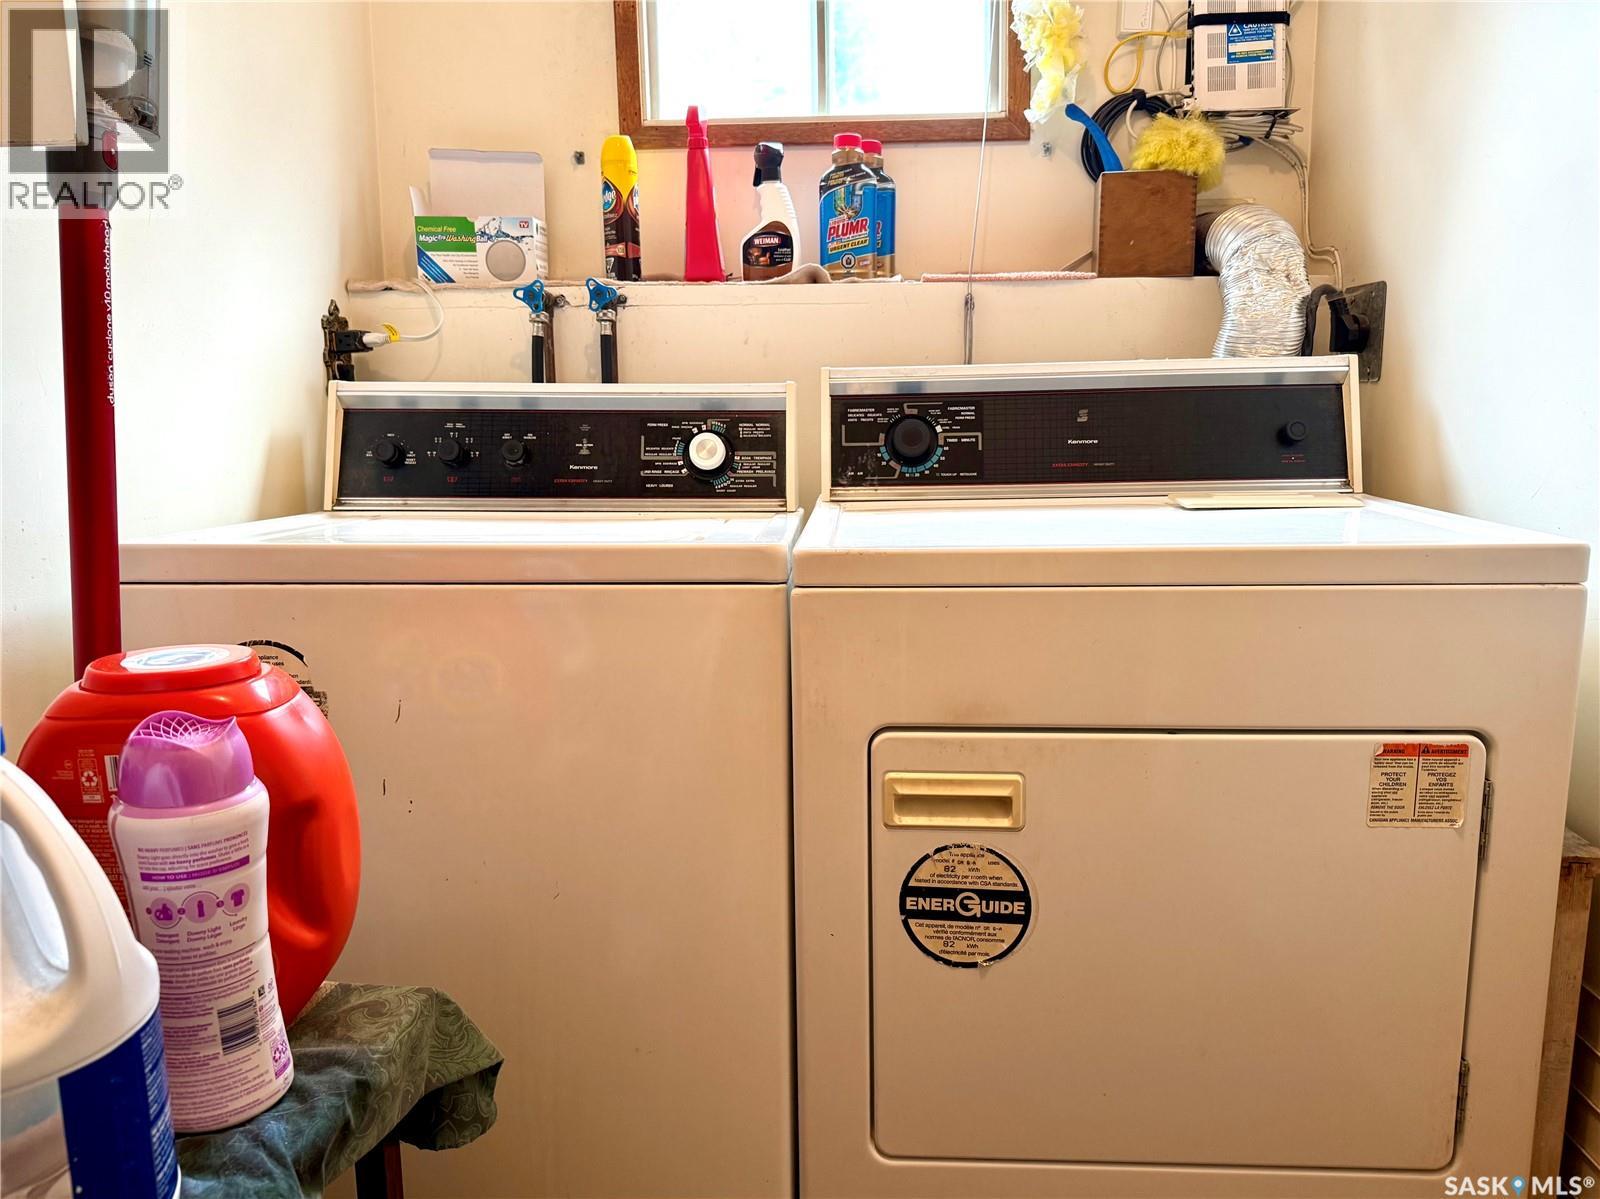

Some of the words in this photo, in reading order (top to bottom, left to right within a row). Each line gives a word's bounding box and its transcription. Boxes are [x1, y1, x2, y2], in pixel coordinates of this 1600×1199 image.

[418, 235, 438, 244] Magic
[446, 234, 476, 244] Washing
[754, 236, 779, 245] WEIMAN
[828, 218, 868, 241] PLUMR
[102, 220, 112, 290] motorhead
[830, 242, 851, 252] URGENT
[850, 239, 868, 248] CLEAR
[105, 312, 114, 362] cyclone
[106, 365, 116, 407] dyson
[906, 892, 1026, 918] ENERGUIDE
